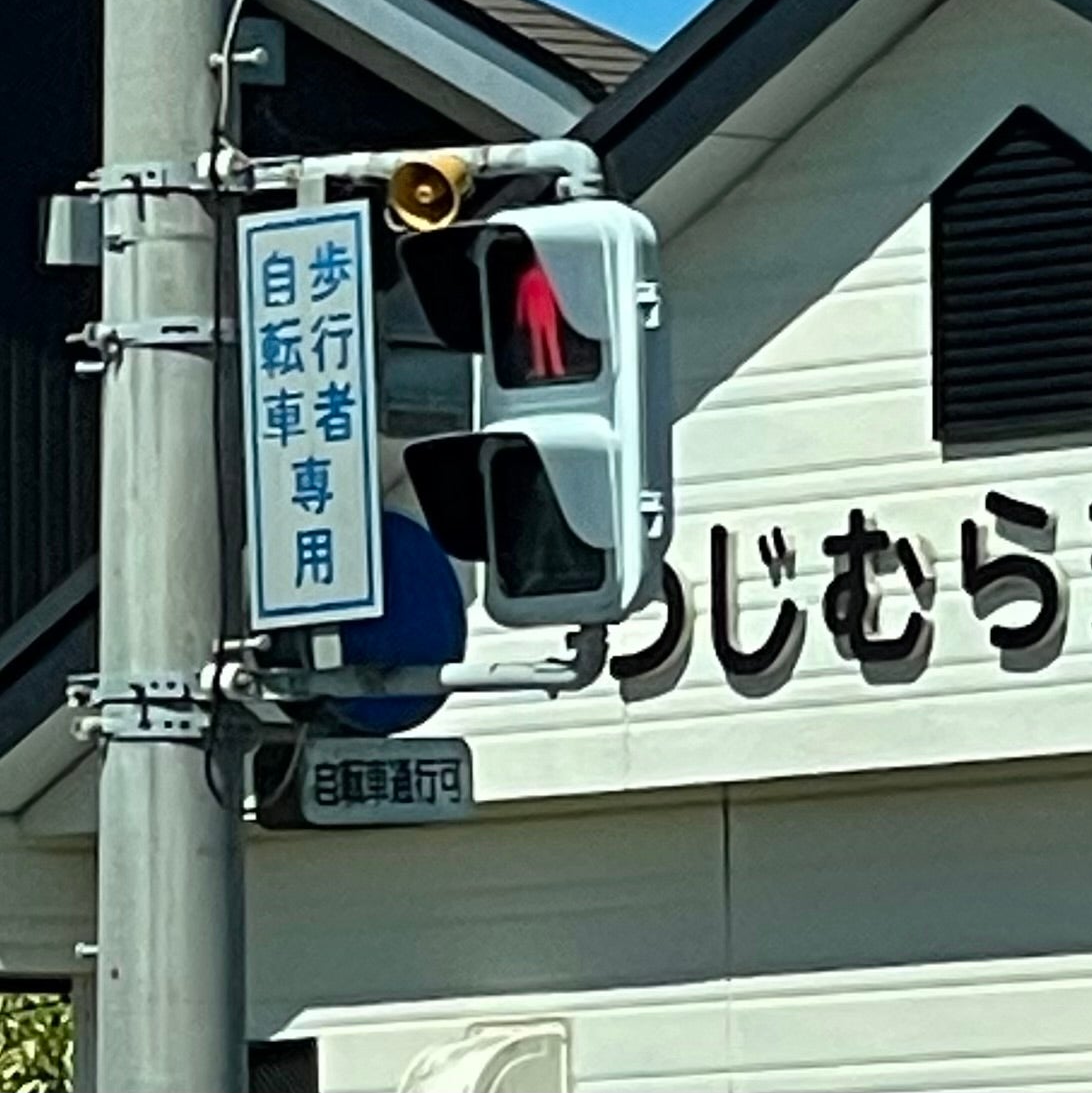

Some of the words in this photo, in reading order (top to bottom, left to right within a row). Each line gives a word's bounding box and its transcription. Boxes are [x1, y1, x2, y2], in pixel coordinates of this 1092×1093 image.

[259, 250, 307, 447] 自転車
[309, 240, 356, 443] 歩行者
[291, 455, 334, 589] 専用
[315, 758, 461, 806] 自転車通行可
